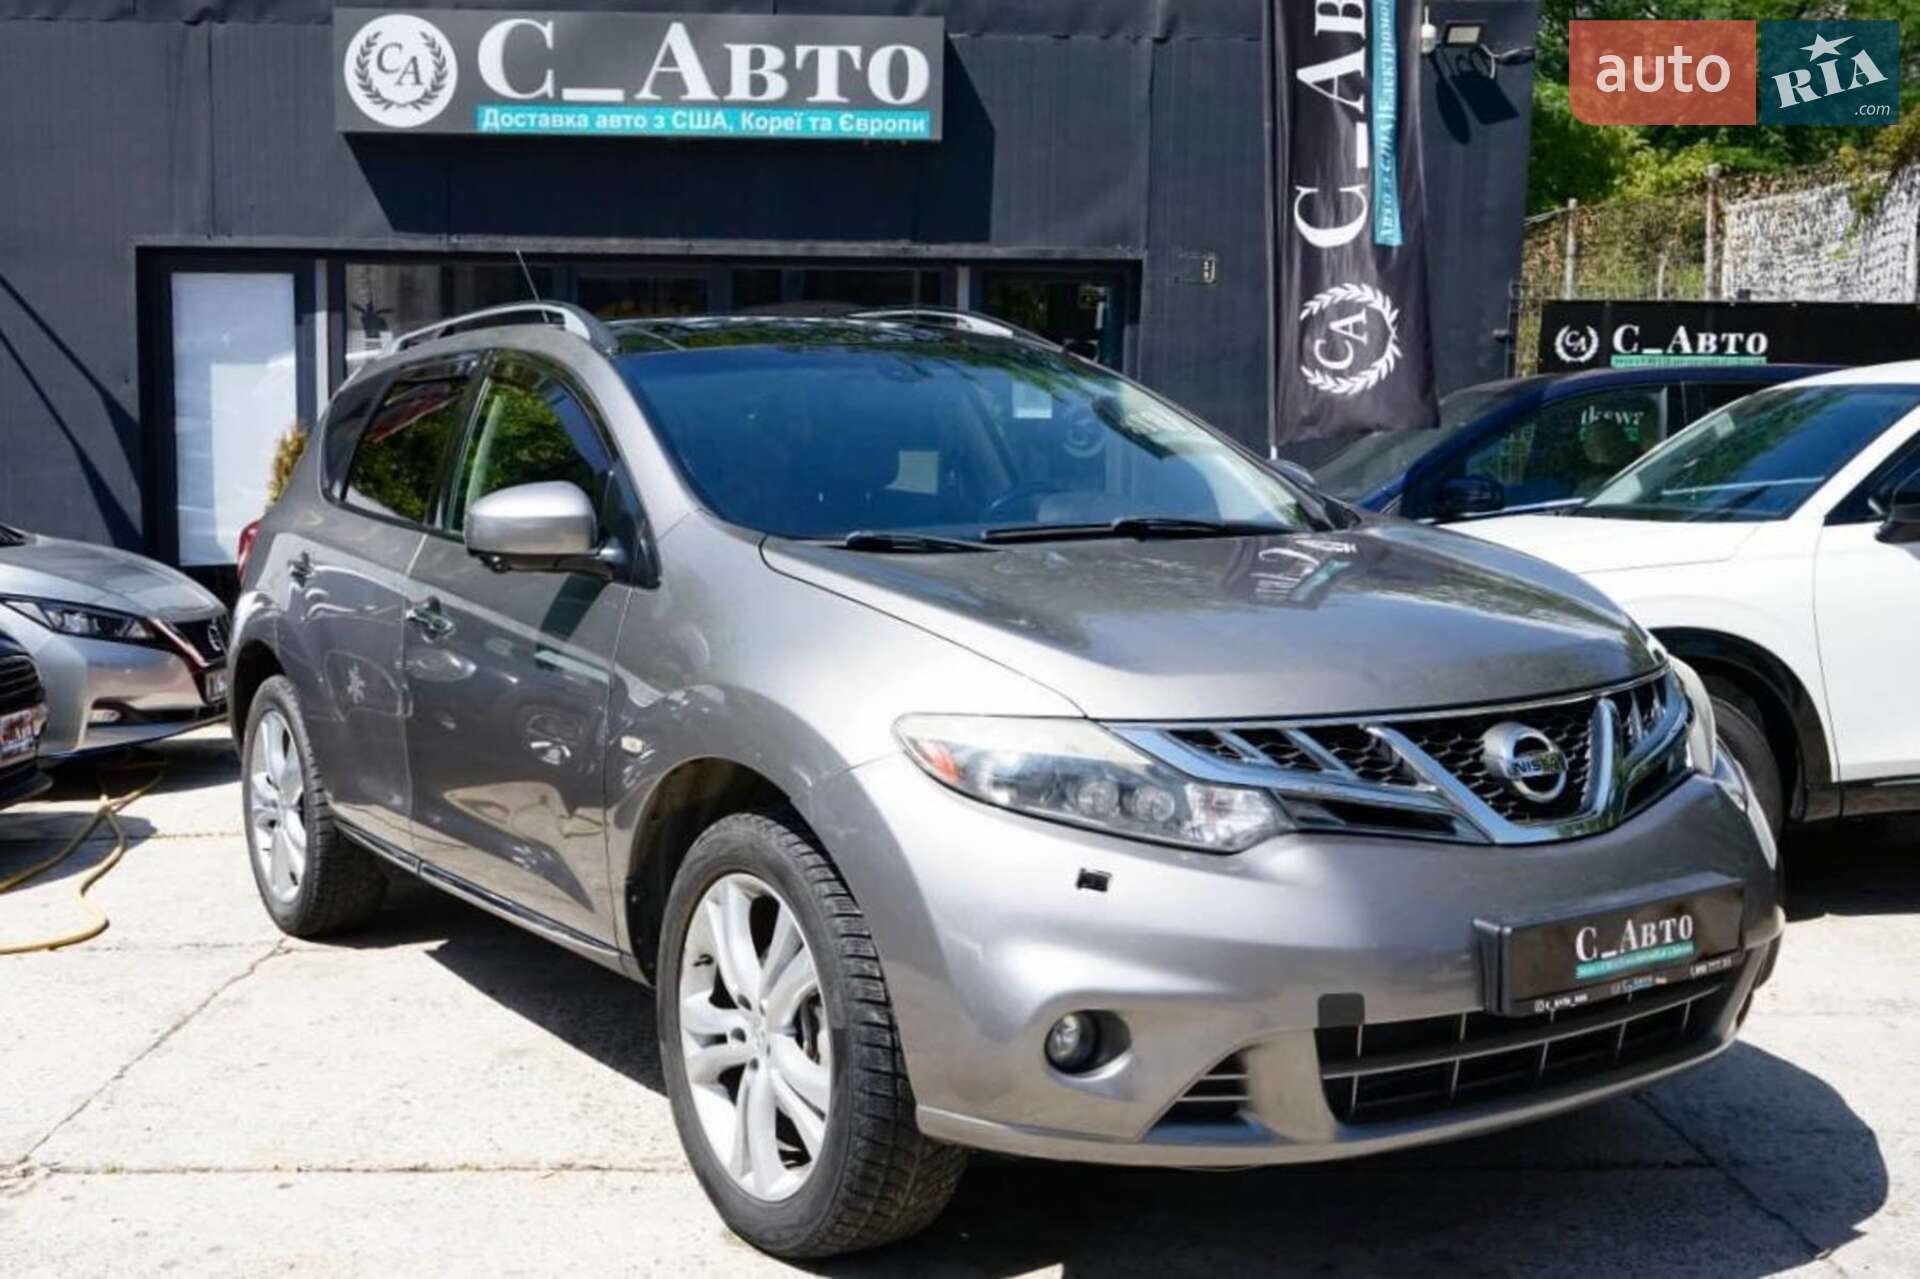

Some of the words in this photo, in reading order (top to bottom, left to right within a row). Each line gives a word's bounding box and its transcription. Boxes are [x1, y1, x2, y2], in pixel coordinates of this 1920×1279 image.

[481, 108, 588, 132] Доставка
[595, 112, 648, 130] авто
[653, 113, 665, 130] з
[671, 109, 734, 132] США,
[741, 112, 803, 134] Кореї
[808, 115, 832, 132] та
[839, 112, 925, 136] Європи
